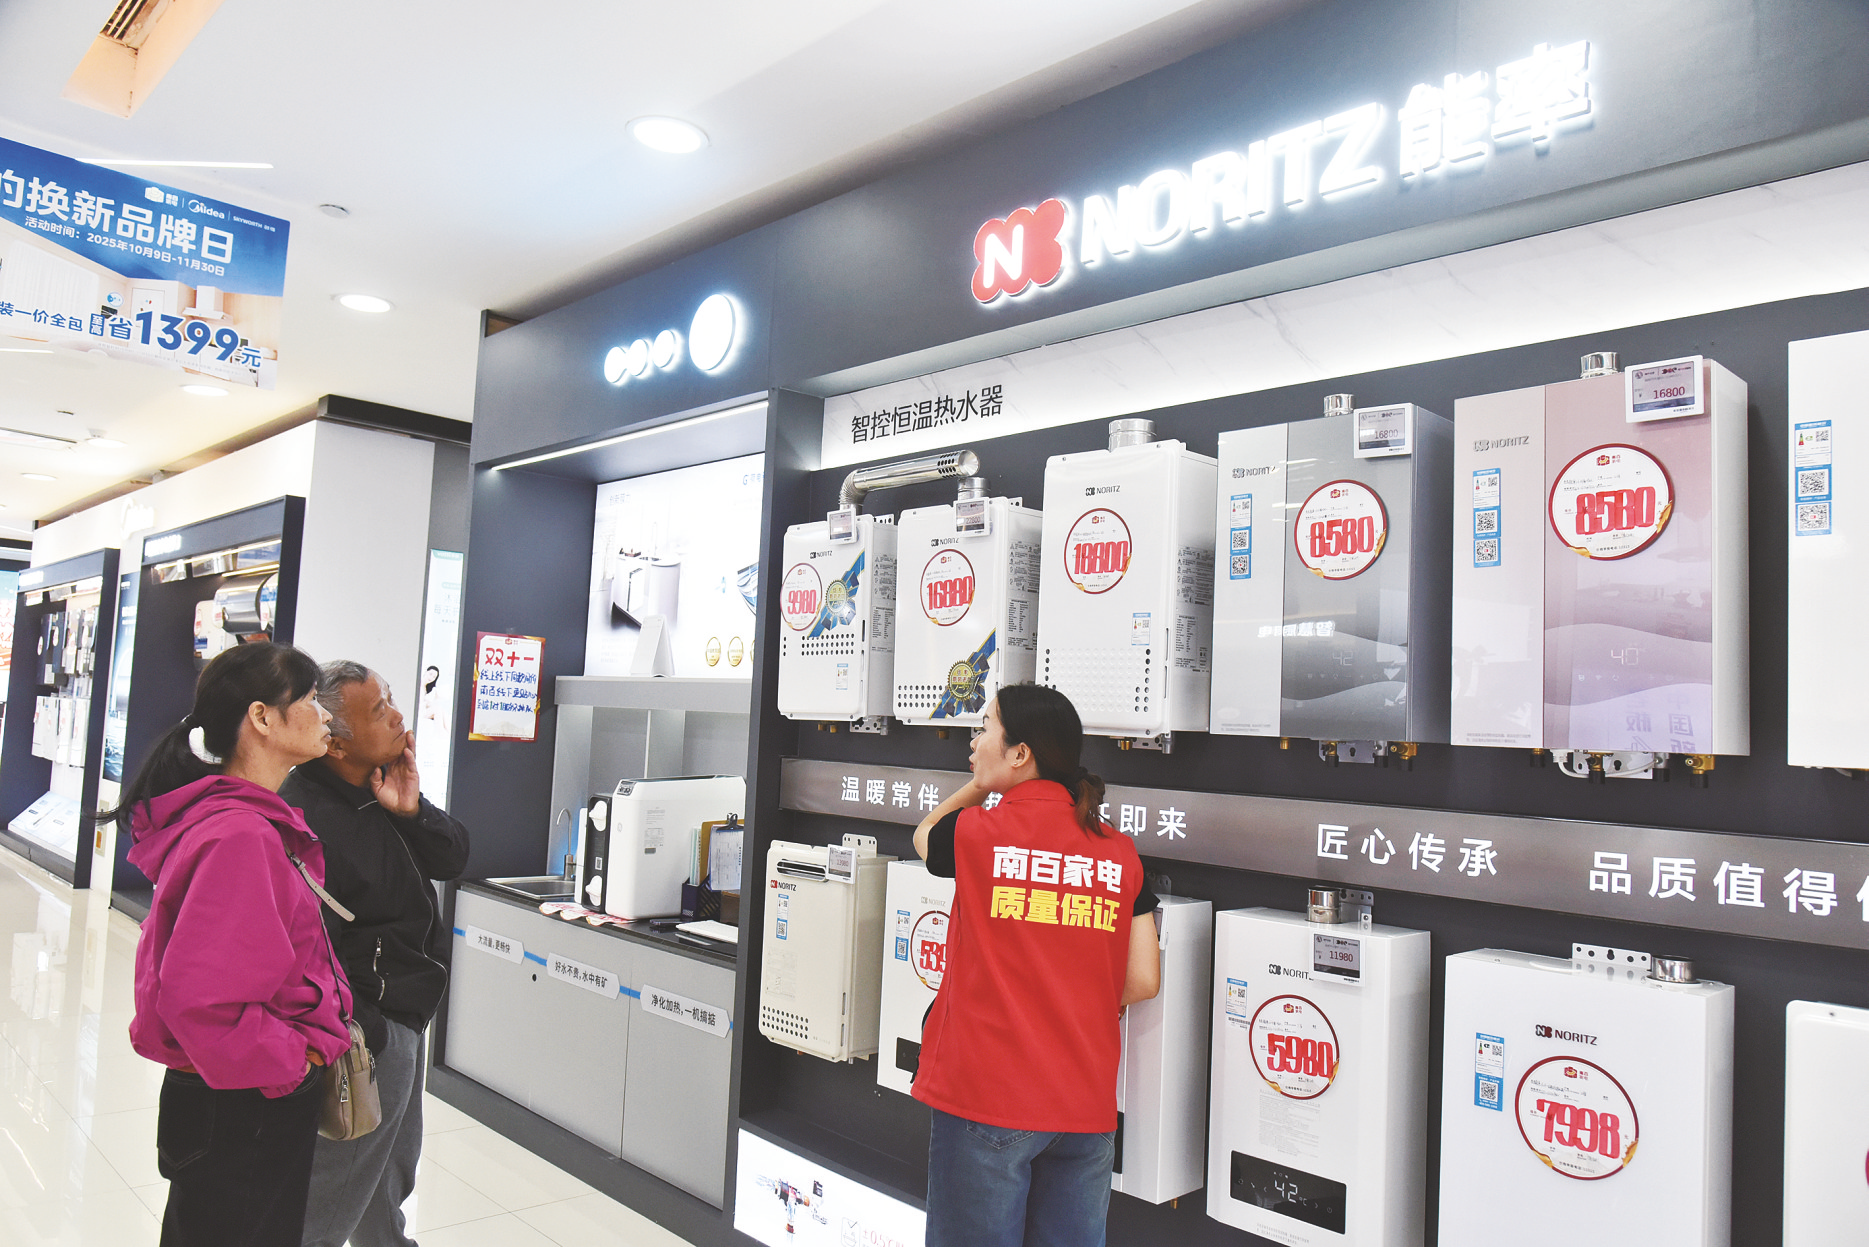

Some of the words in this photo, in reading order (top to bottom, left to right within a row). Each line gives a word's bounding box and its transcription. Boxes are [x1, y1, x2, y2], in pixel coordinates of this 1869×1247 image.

[1081, 102, 1383, 266] NORITZ
[188, 199, 225, 219] Midea
[1653, 386, 1685, 399] 16800
[851, 384, 1003, 444] 智控恒温热水器
[1491, 435, 1530, 449] NORITZ
[1096, 485, 1121, 494] NORITZ
[1576, 486, 1656, 535] 8580
[1309, 515, 1375, 558] 8580
[787, 589, 817, 615] 9980
[485, 647, 534, 668] 双十一
[1332, 650, 1353, 666] 42
[1610, 647, 1639, 666] 40
[840, 775, 939, 812] 温暖常伴
[1316, 823, 1499, 878] 匠心传承
[993, 845, 1122, 894] 南百家电
[778, 881, 797, 891] NORITZ
[990, 885, 1121, 933] 质量保证
[1329, 950, 1354, 962] 11980
[1282, 968, 1314, 981] NORIT
[1554, 1029, 1598, 1046] NORITZ
[1267, 1033, 1334, 1078] 5980
[1536, 1098, 1621, 1160] 7998
